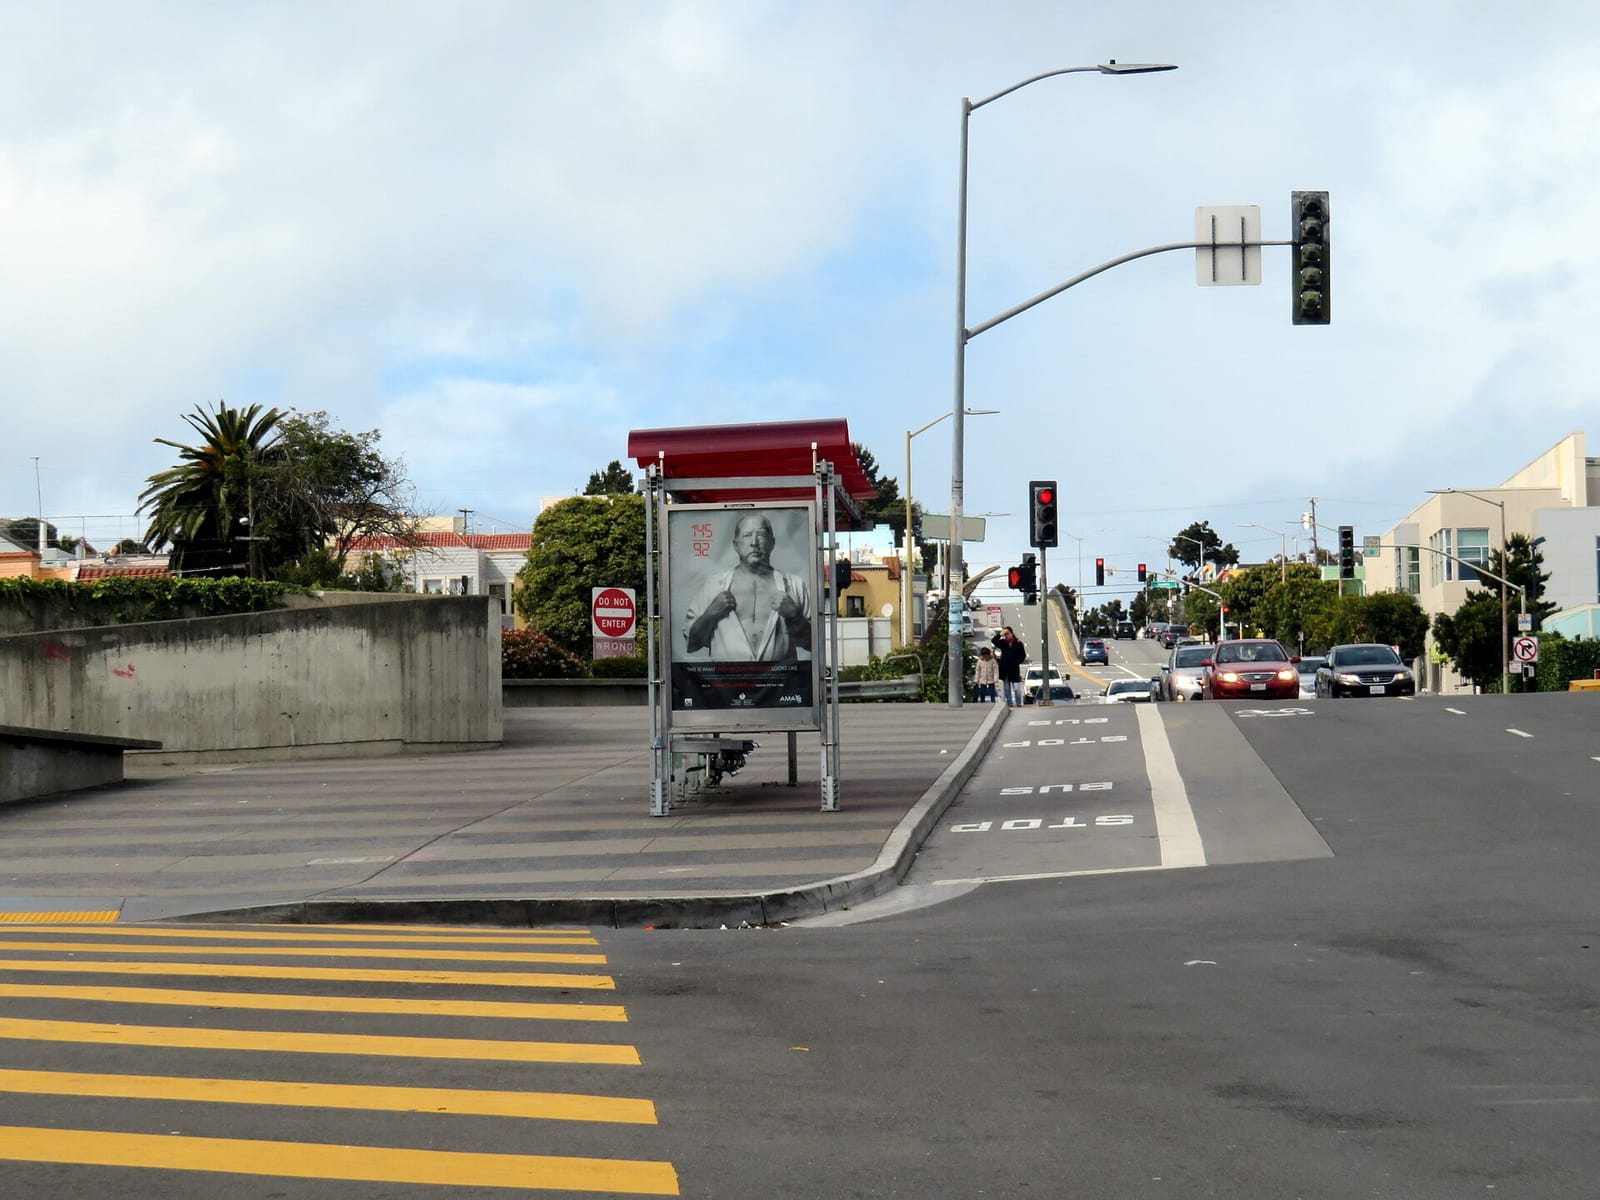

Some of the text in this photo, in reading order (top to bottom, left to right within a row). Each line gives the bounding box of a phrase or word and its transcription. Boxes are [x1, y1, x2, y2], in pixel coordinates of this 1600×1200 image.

[691, 523, 713, 538] 145
[693, 542, 710, 557] 92
[599, 597, 629, 606] DO NOT
[601, 619, 626, 628] ENTER
[595, 641, 633, 651] WRONG
[1028, 717, 1109, 727] BUS
[1003, 735, 1128, 748] STOP
[1000, 781, 1113, 796] BUS
[950, 814, 1134, 833] STOP
